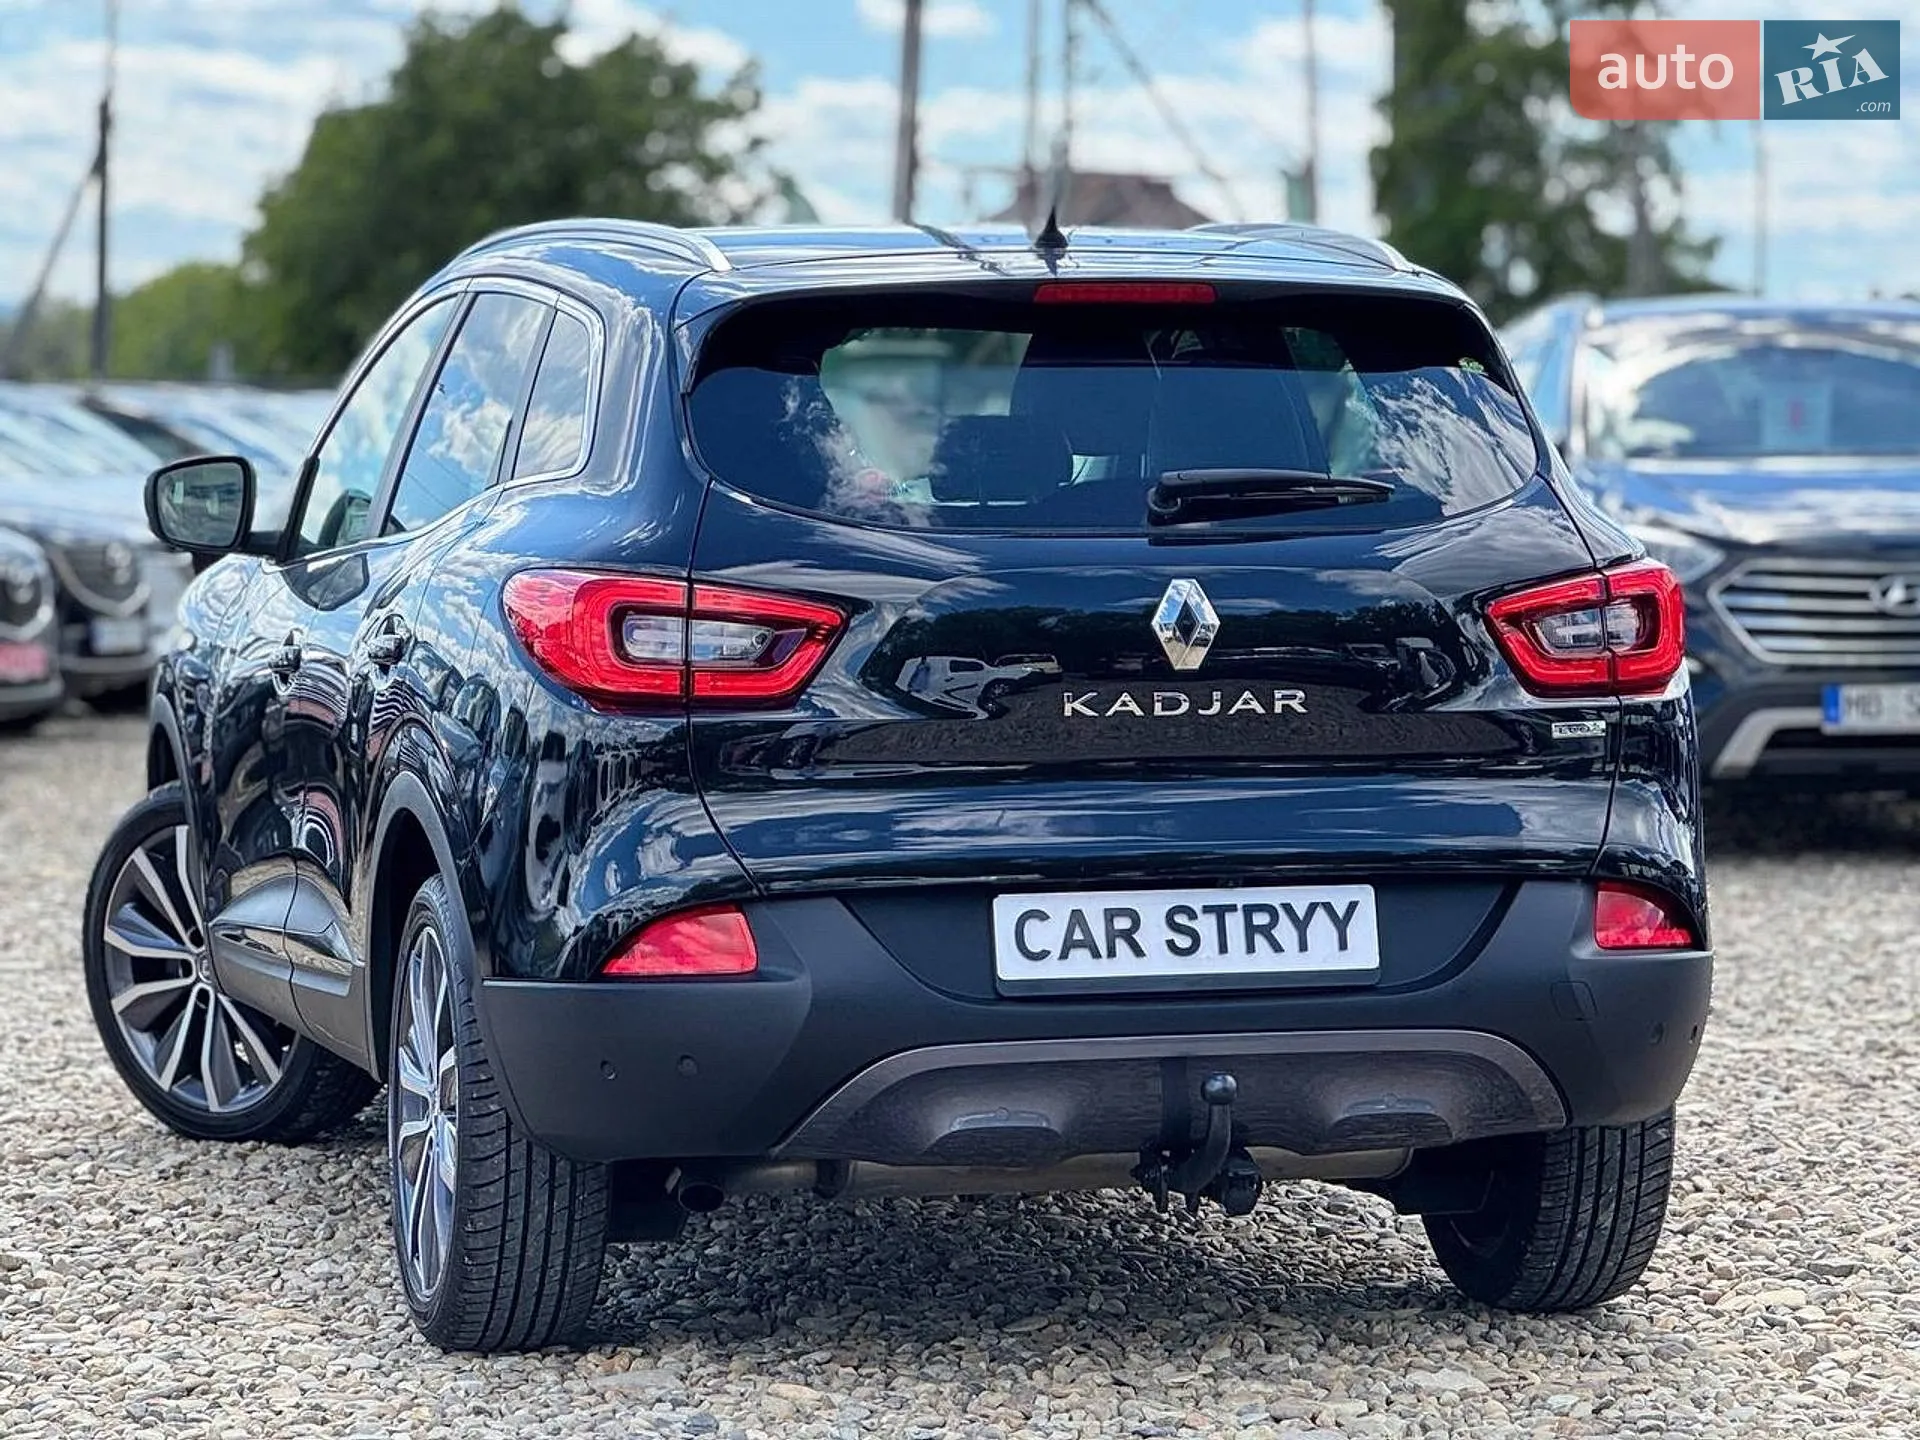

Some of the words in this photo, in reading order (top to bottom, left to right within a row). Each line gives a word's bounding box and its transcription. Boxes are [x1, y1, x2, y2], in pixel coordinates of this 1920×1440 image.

[1063, 689, 1308, 717] KADJAR
[1014, 907, 1146, 962] CAR
[1164, 900, 1360, 957] STRYY
